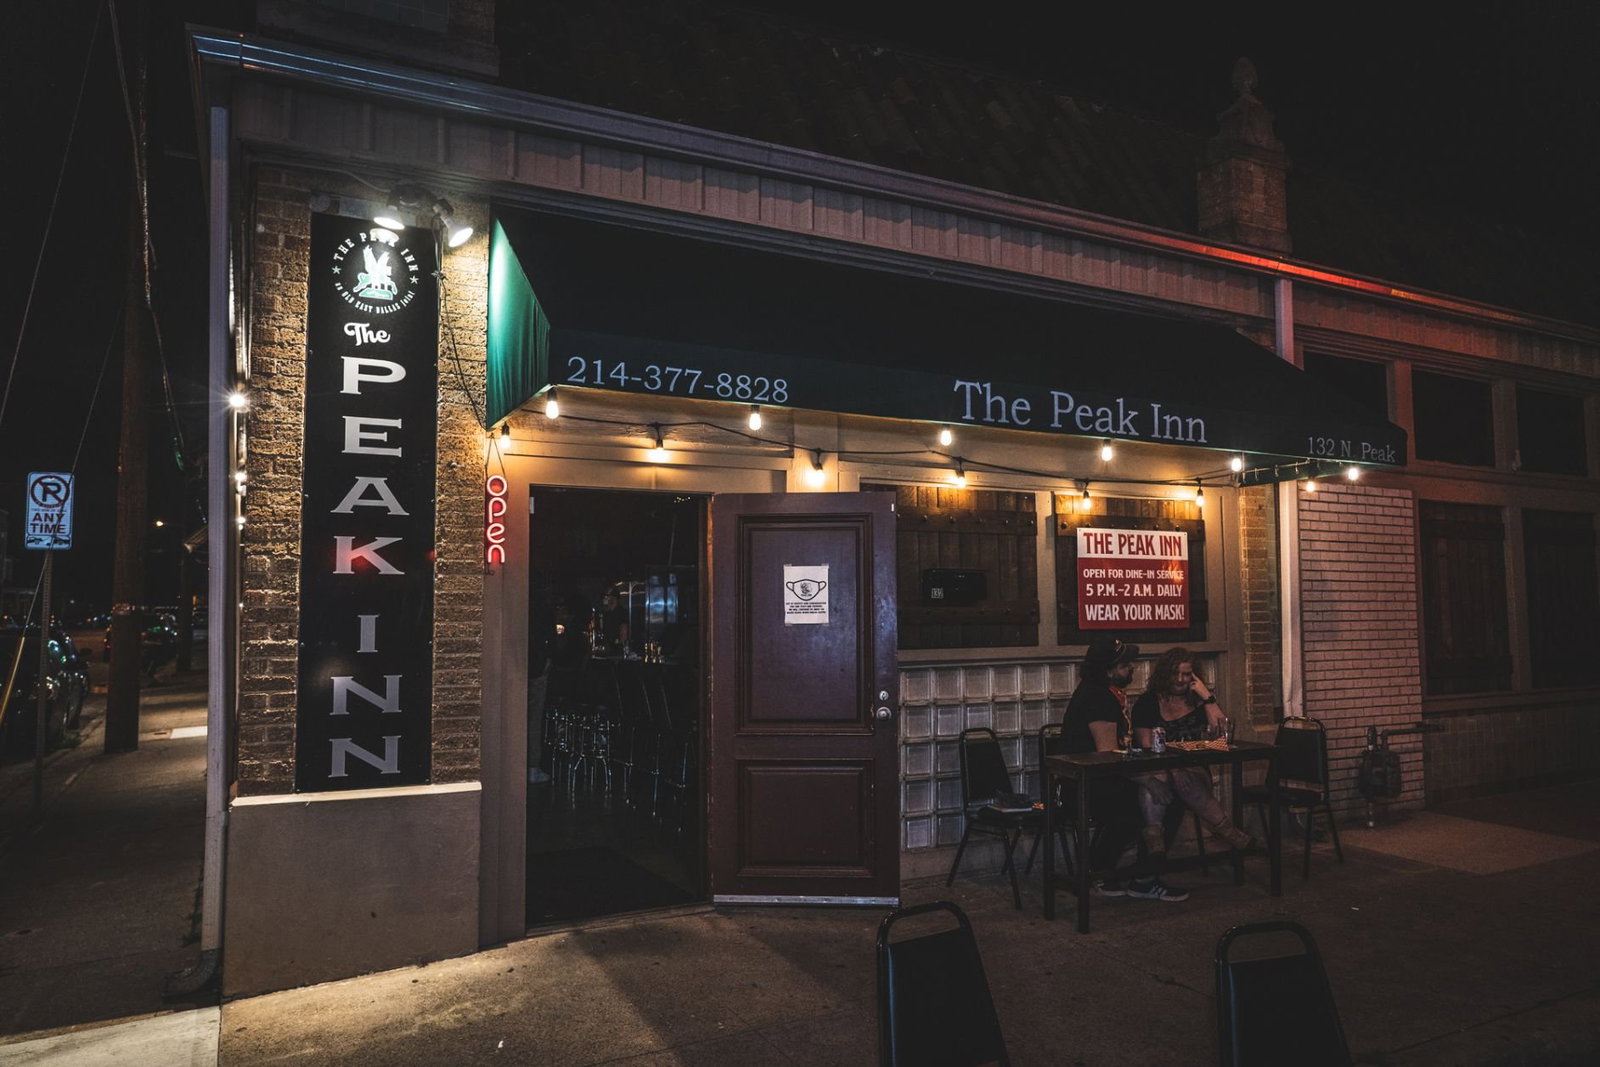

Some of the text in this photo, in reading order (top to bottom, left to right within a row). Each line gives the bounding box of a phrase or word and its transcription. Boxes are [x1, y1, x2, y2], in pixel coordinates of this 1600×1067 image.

[333, 238, 355, 261] THE
[400, 248, 419, 272] INN
[343, 322, 391, 346] The
[566, 356, 789, 403] 214-377-8828
[953, 379, 1208, 443] The Peak Inn
[1308, 436, 1335, 456] 132
[1361, 442, 1397, 463] Peak
[30, 523, 66, 533] TIME
[32, 512, 64, 522] ANY
[1083, 532, 1182, 557] THE PEAK INN
[328, 355, 410, 778] PEAK INN
[1083, 568, 1106, 579] OPEN
[1108, 569, 1124, 579] FOR
[1157, 570, 1185, 580] SERVICE
[1086, 583, 1094, 597] 5
[1133, 584, 1155, 597] A.M.
[1157, 584, 1183, 597] DAILY
[1085, 603, 1185, 621] WEAR YOUR MASK!
